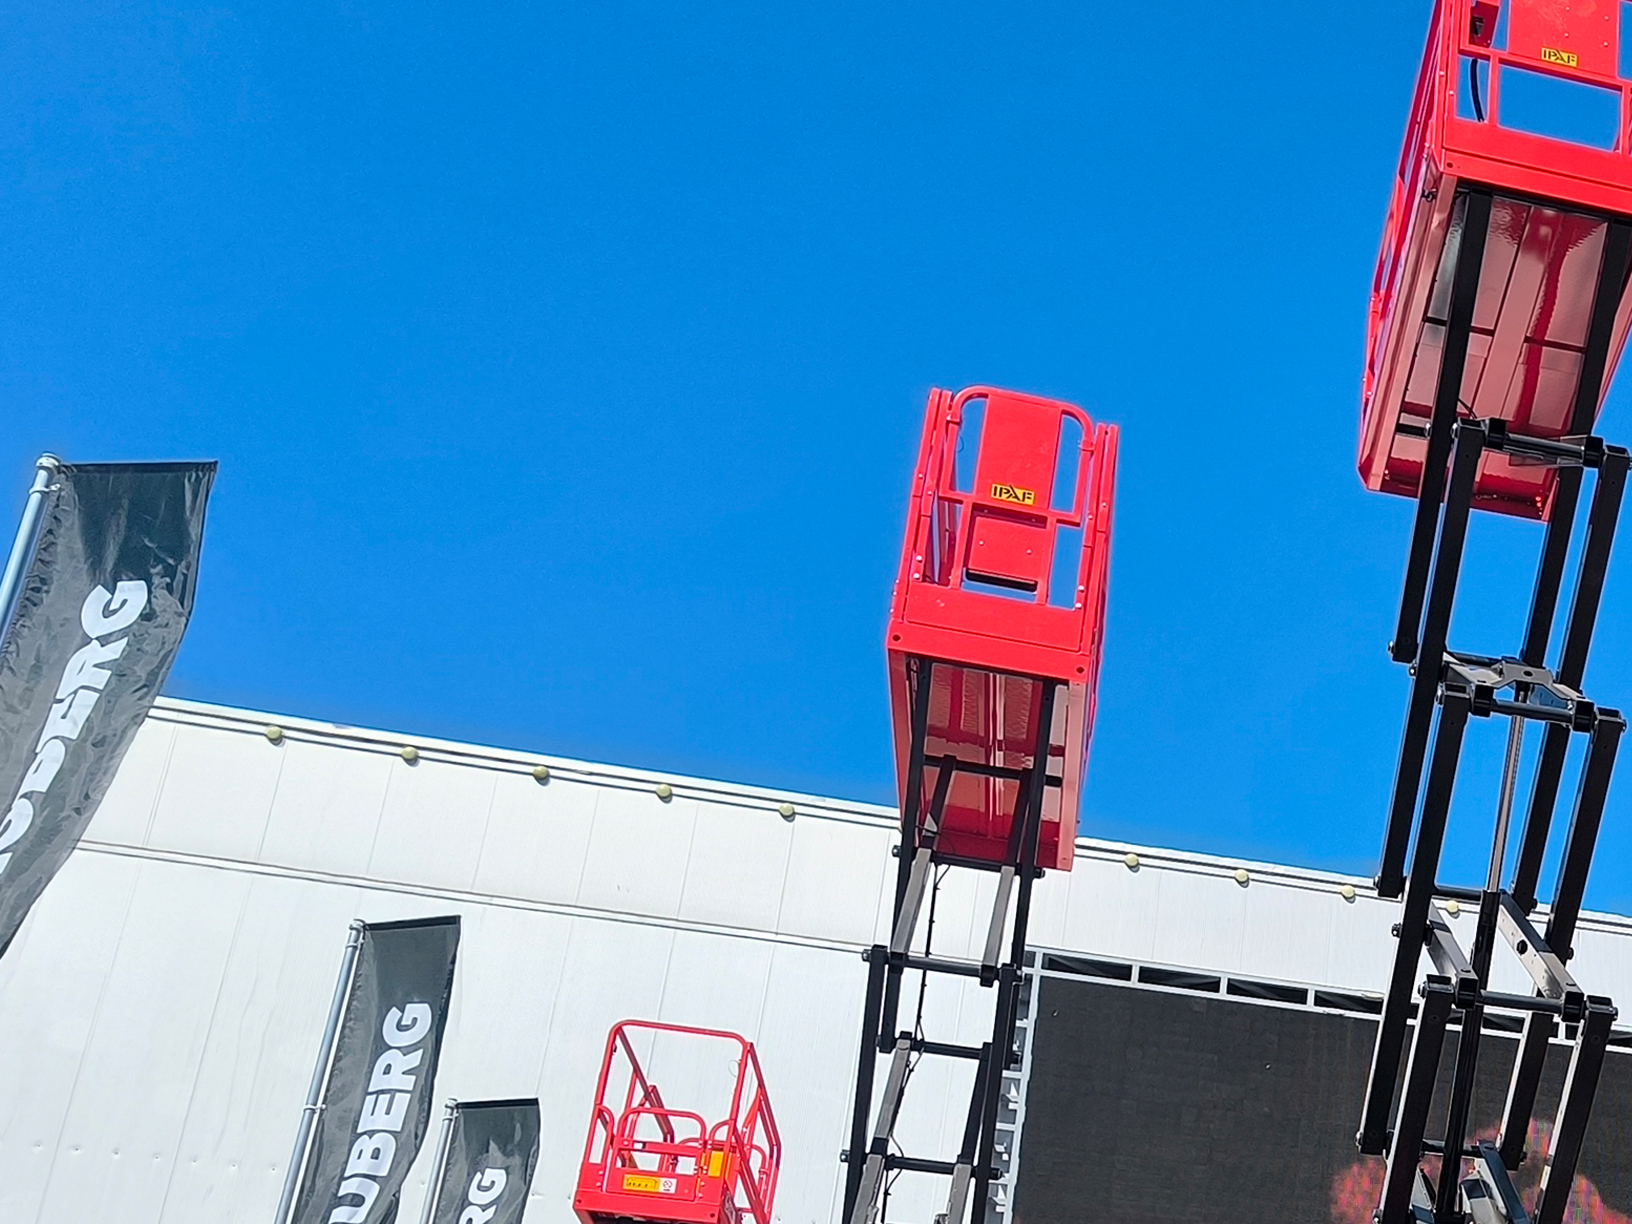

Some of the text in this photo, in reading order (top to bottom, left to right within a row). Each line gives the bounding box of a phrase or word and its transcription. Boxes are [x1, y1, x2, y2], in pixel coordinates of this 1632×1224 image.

[1542, 49, 1577, 66] IPAF
[992, 484, 1035, 503] IPAF
[0, 580, 148, 873] UBERG
